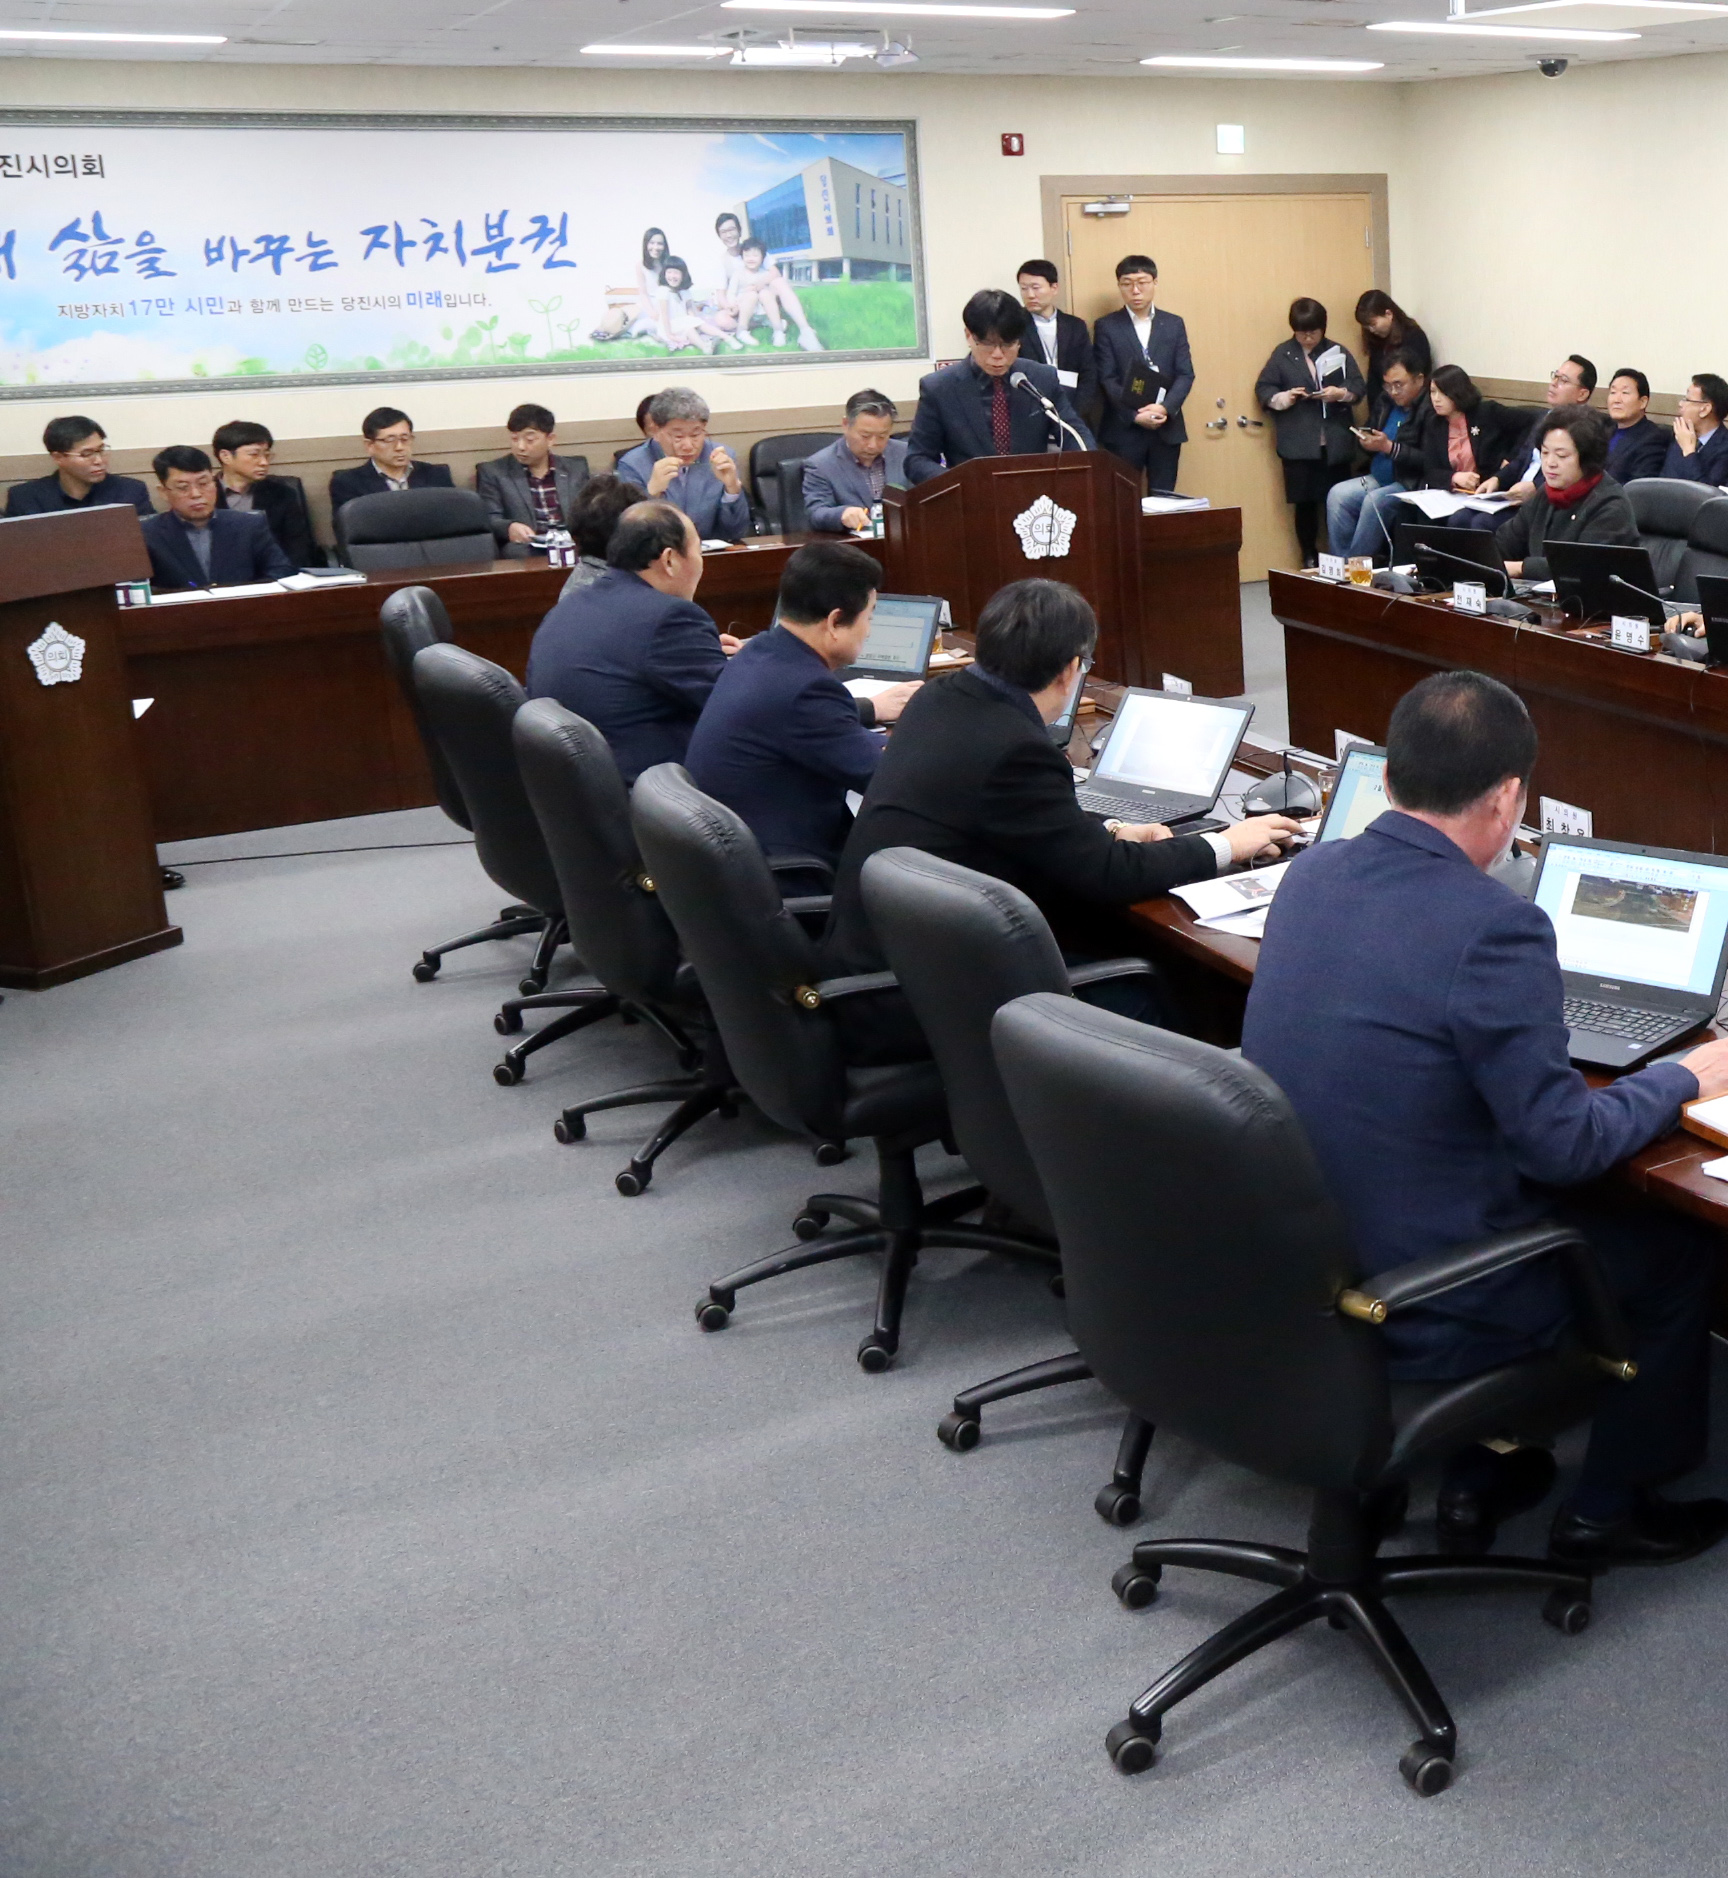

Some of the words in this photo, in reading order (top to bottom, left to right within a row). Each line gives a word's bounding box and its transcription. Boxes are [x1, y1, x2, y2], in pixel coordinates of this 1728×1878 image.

[48, 210, 178, 282] 삶을
[204, 230, 339, 275] 바꾸는
[360, 209, 577, 273] 자치분권
[57, 303, 125, 319] 지방자치
[129, 298, 174, 316] 17만
[185, 296, 243, 316] 시민과
[250, 298, 281, 313] 함께
[288, 297, 334, 313] 만드는
[341, 295, 401, 311] 당진시의
